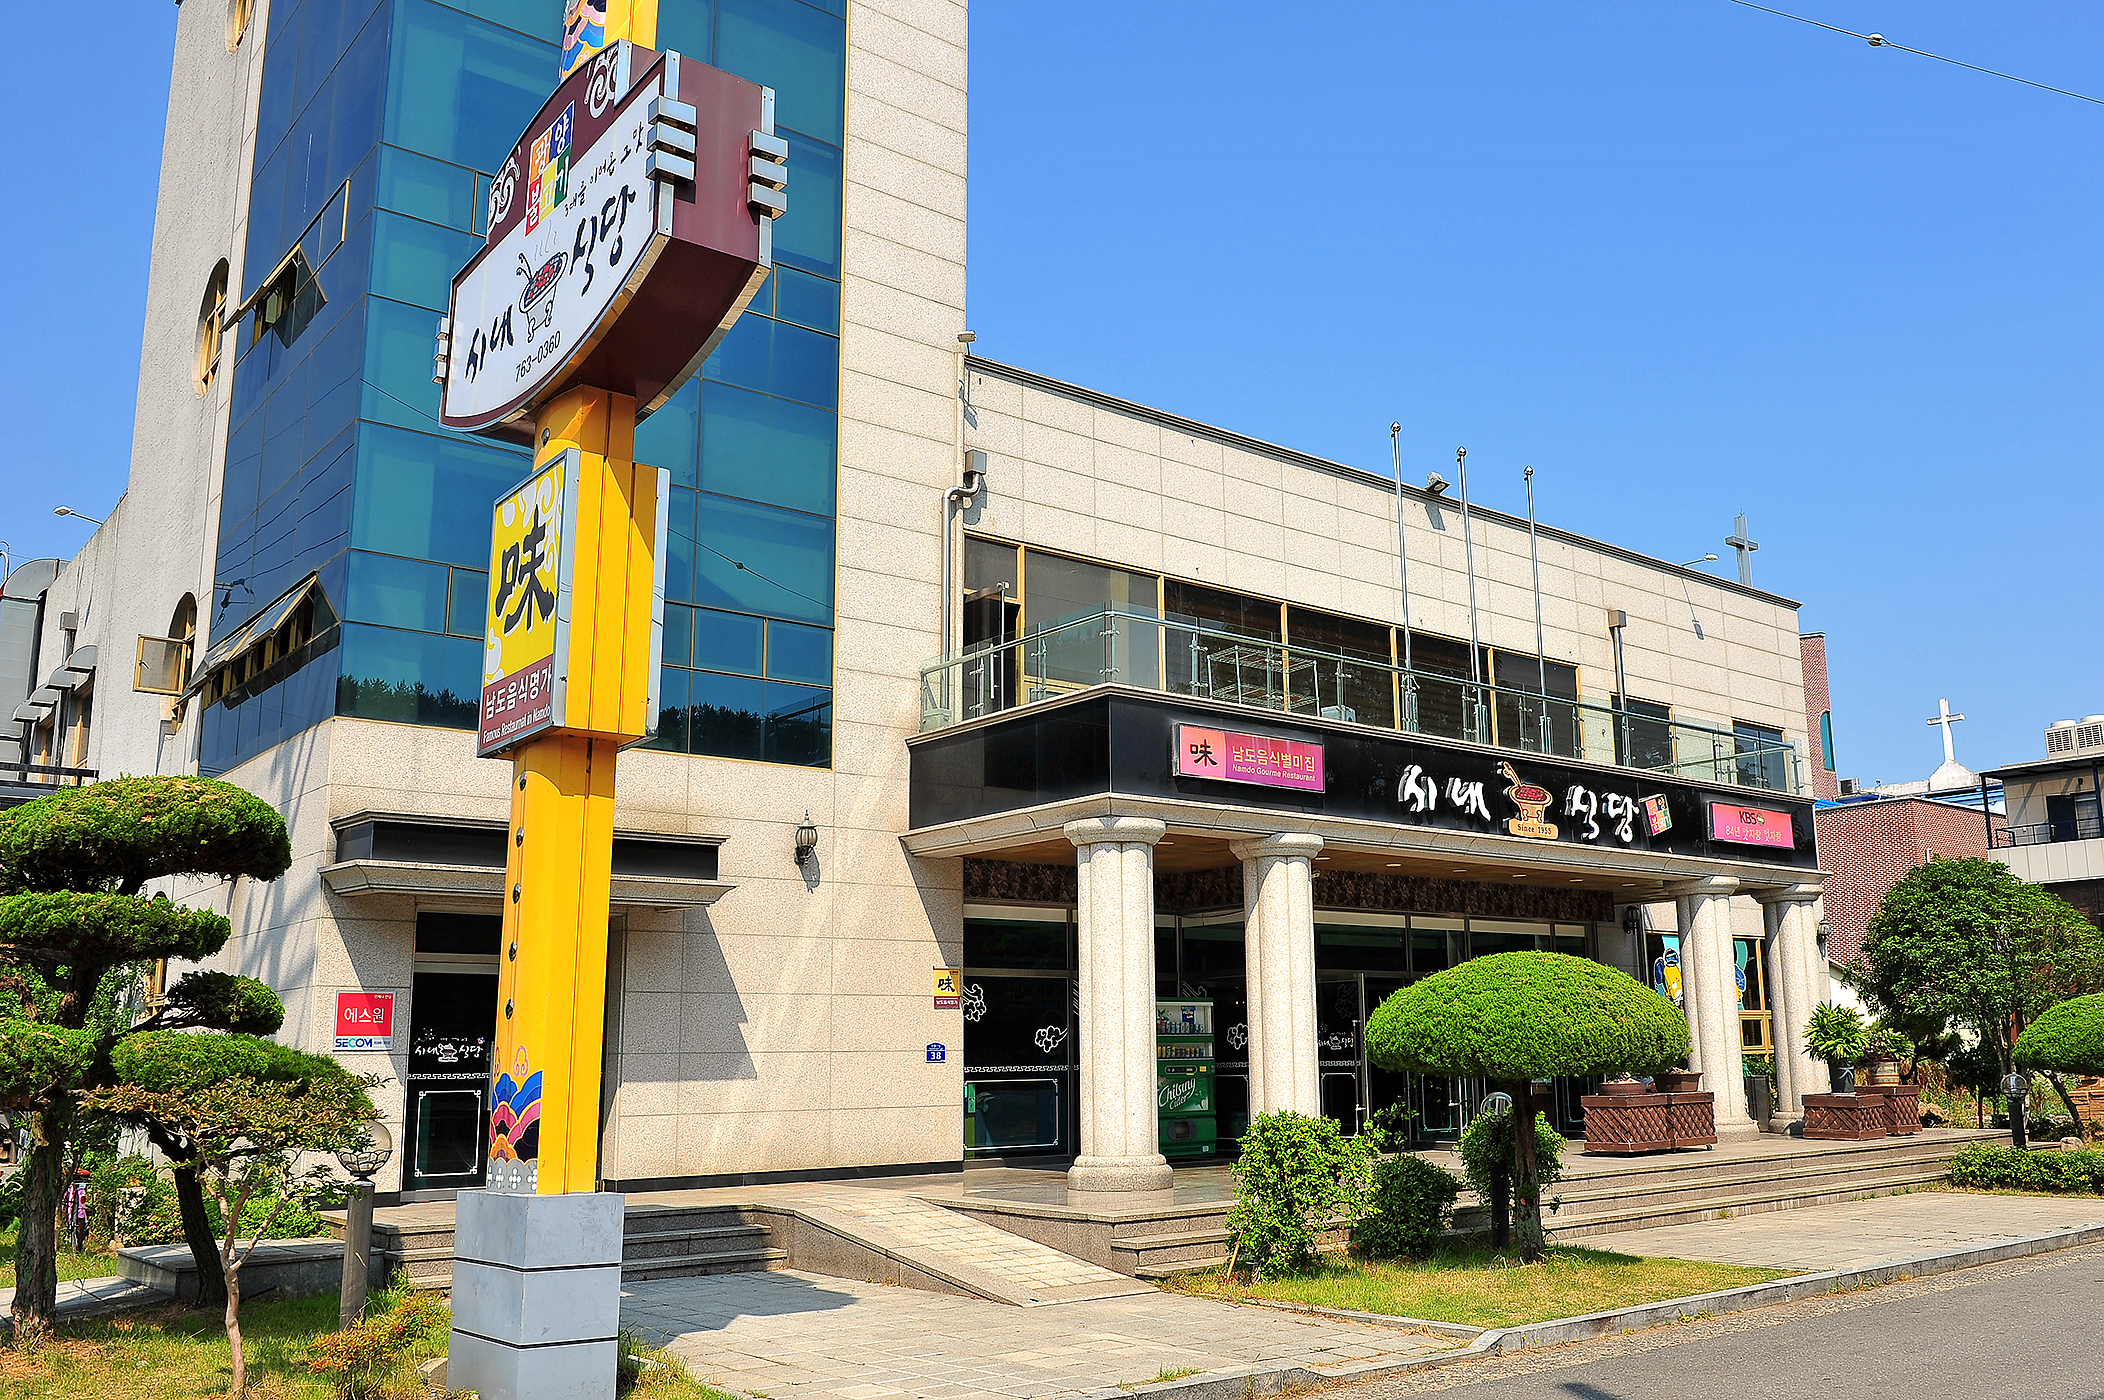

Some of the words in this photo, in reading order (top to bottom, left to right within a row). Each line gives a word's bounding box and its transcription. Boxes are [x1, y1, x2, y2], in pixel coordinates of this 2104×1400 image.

[534, 112, 570, 174] 광양
[589, 151, 617, 177] 이어온
[620, 144, 632, 164] 그
[529, 154, 570, 228] 불고기
[569, 184, 637, 297] 식당
[514, 330, 561, 383] 763-0360
[495, 504, 556, 633] 味
[485, 663, 552, 720] 남도음식명가
[1189, 738, 1219, 768] 味
[1232, 745, 1316, 773] 남도음식별미집
[1232, 763, 1256, 774] Namdo
[1282, 770, 1316, 782] Restaurant
[1567, 784, 1640, 843] 식당
[1738, 810, 1757, 825] KBS
[1517, 823, 1535, 834] Since
[1537, 825, 1552, 835] 1955
[1725, 825, 1741, 838] 84년
[938, 976, 956, 992] 味
[344, 1007, 385, 1023] 에스원
[335, 1037, 373, 1048] SECOM
[930, 1051, 942, 1060] 38
